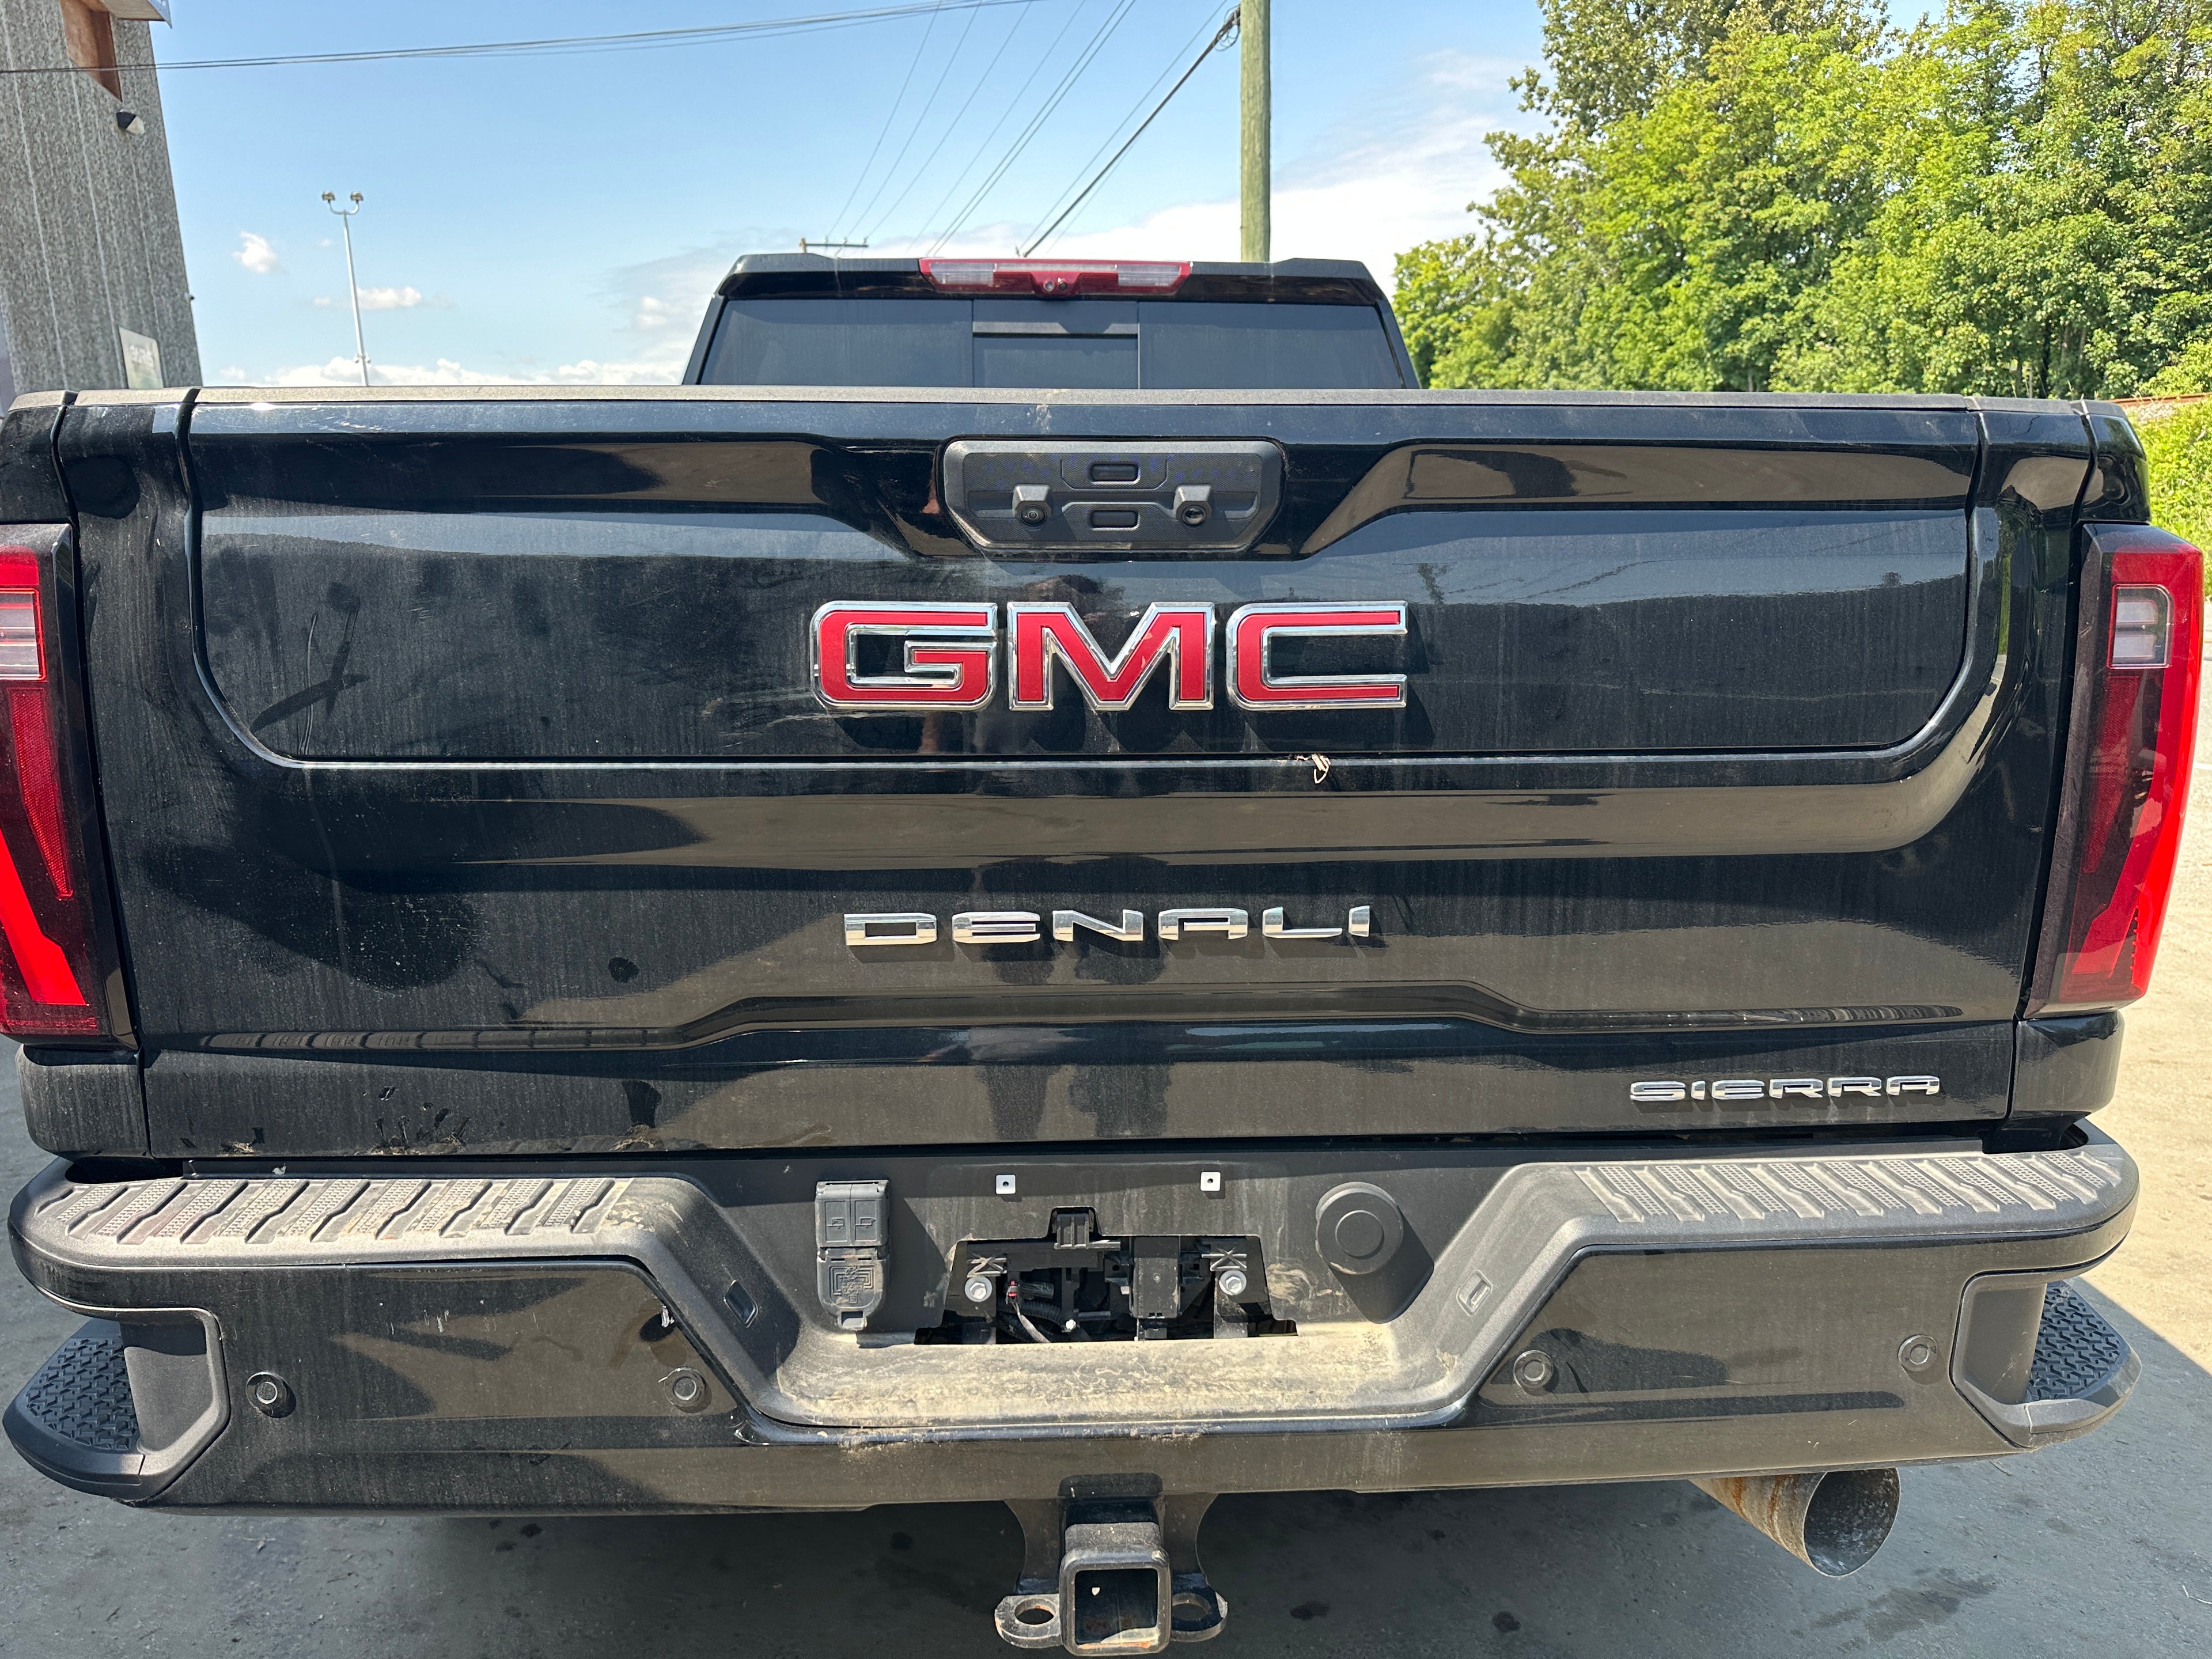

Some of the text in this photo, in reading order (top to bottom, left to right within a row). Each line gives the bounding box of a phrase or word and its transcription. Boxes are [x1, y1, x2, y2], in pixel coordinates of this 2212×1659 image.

[810, 601, 1408, 711] GMC
[843, 905, 1371, 946] DENALI
[1630, 1075, 1940, 1101] SIERRA
